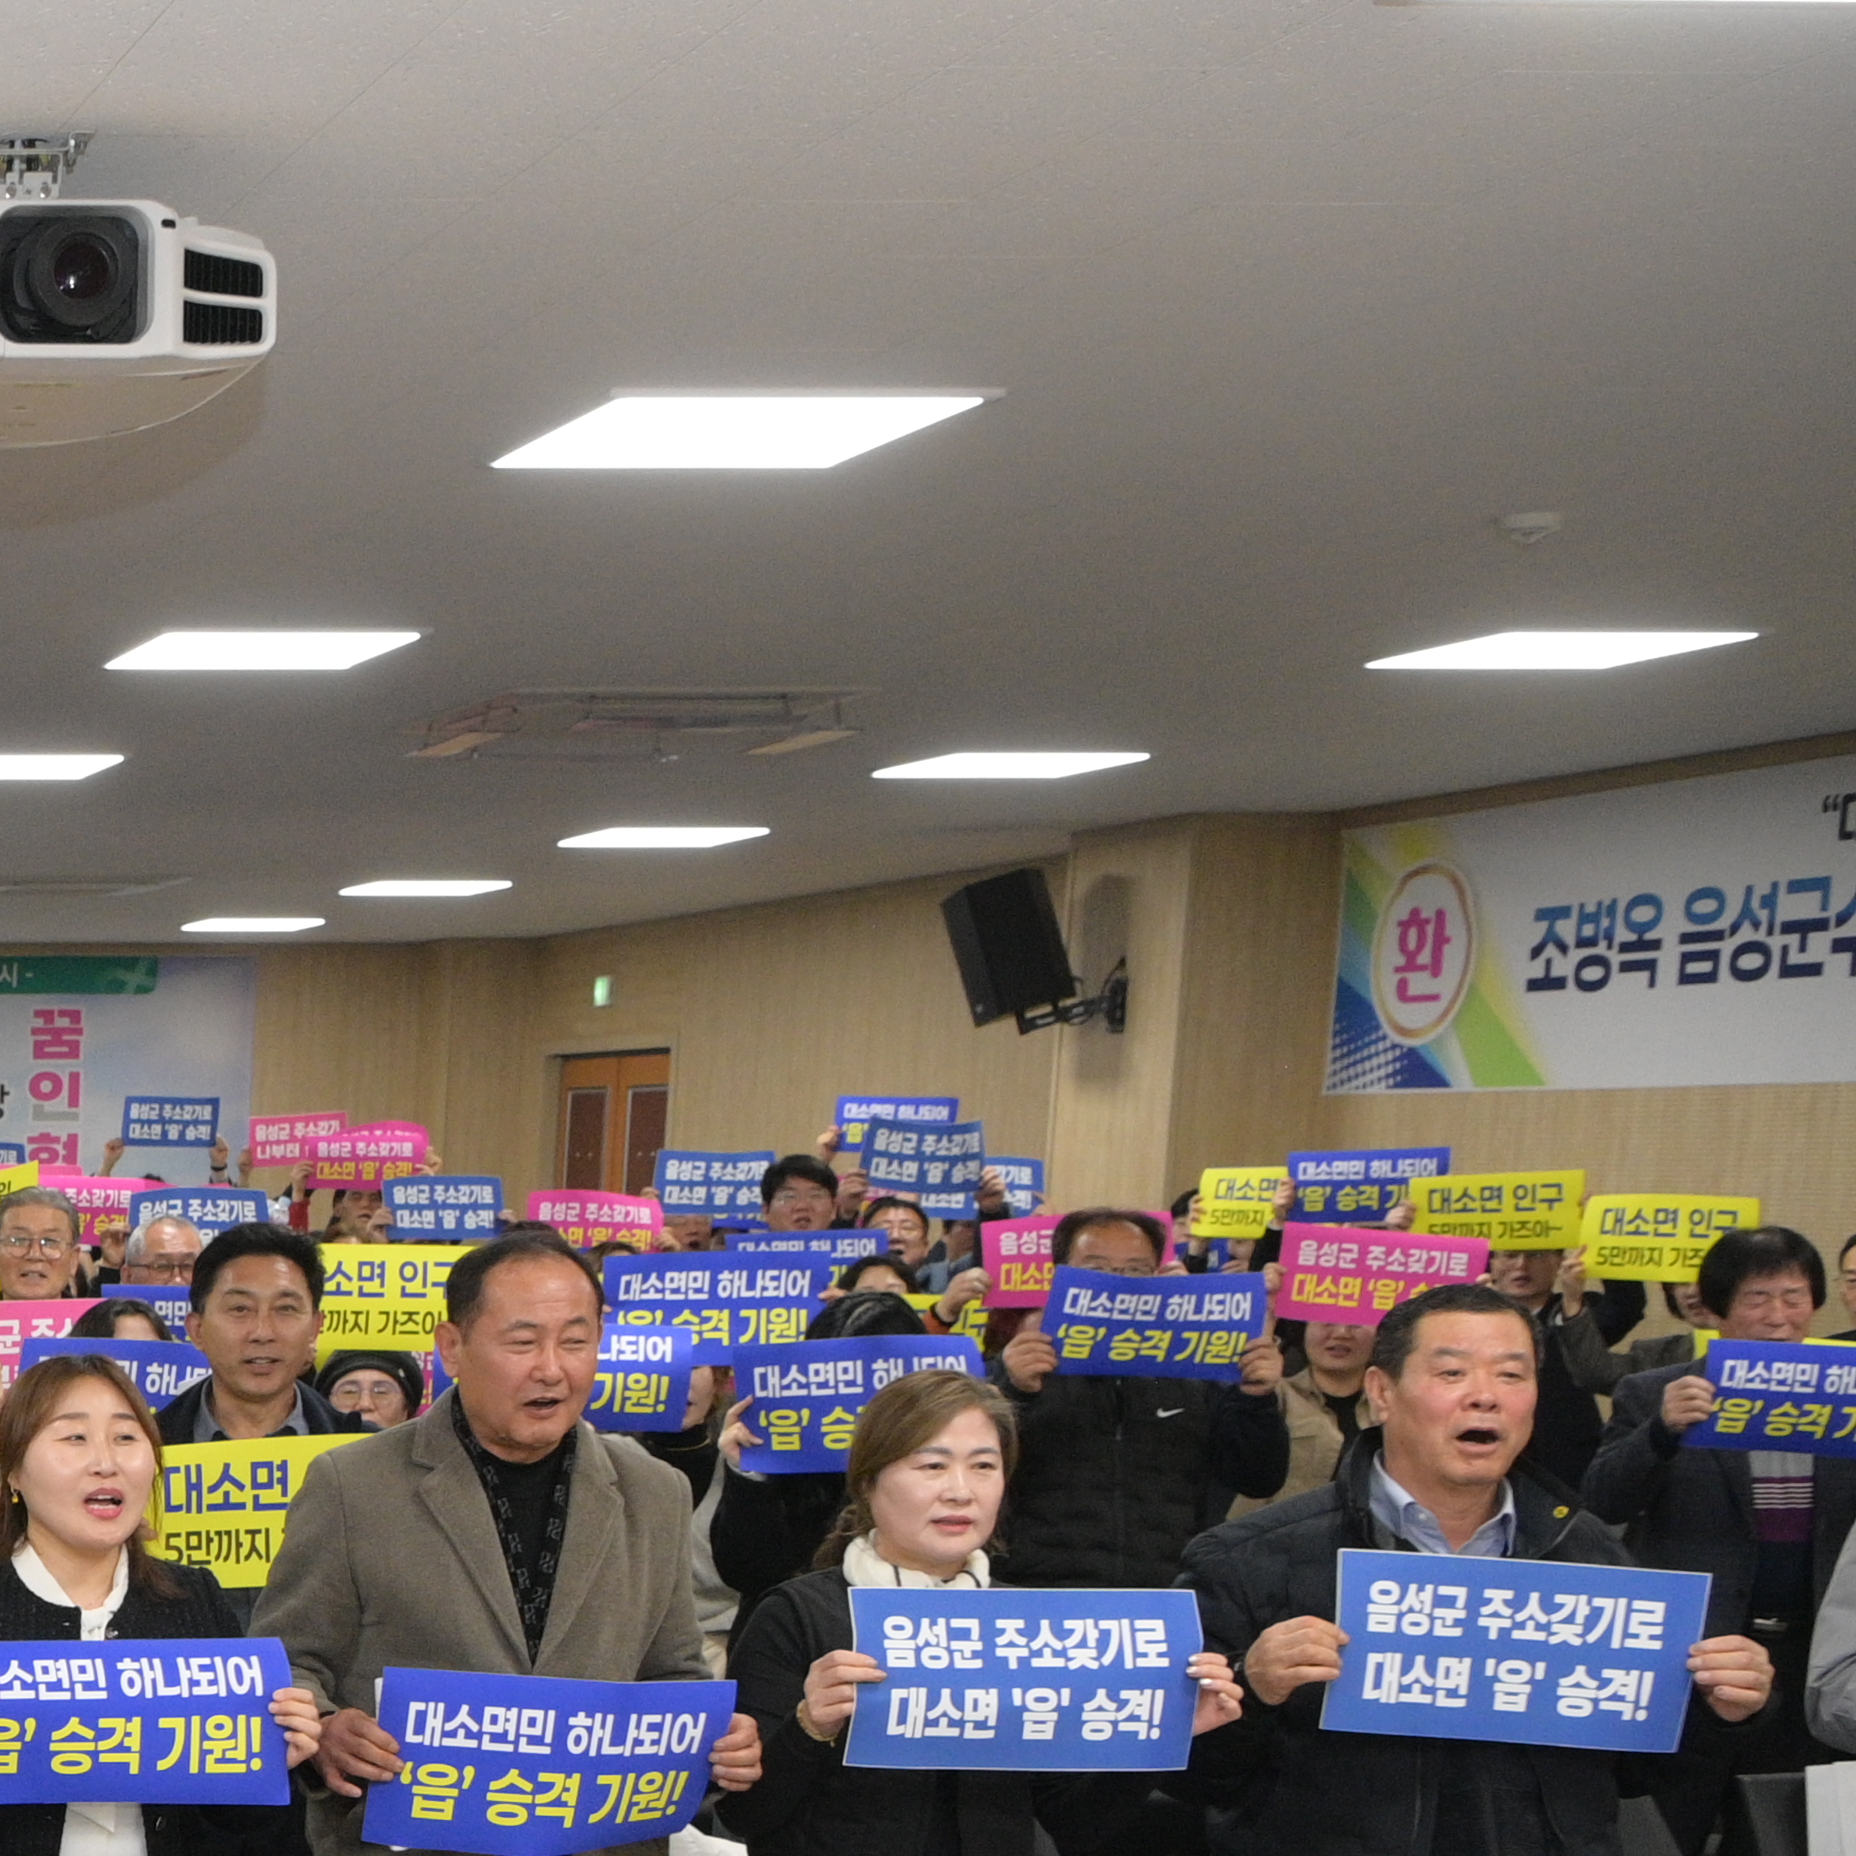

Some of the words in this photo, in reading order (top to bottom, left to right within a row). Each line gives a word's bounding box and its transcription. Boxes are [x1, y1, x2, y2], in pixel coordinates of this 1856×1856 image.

[1394, 906, 1451, 1005] 환
[1525, 892, 1664, 992] 조병옥
[30, 1008, 84, 1061] 꿈
[393, 1185, 430, 1204] 음성군
[433, 1185, 494, 1204] 주소갖기로
[1428, 1184, 1504, 1214] 대소면
[1513, 1183, 1563, 1212] 인구
[397, 1210, 435, 1229] 대소면
[464, 1210, 494, 1229] 승격!
[1298, 1241, 1359, 1269] 음성군
[1366, 1246, 1469, 1277] 주소갖기로
[619, 1271, 710, 1301] 대소면민
[718, 1269, 812, 1299] 하나되어
[1063, 1288, 1159, 1321] 대소면민
[1165, 1290, 1252, 1322] 하나되어
[1292, 1274, 1362, 1307] 대소면
[739, 1308, 807, 1345] 기원!
[1110, 1327, 1176, 1361] 승격
[1181, 1330, 1247, 1364] 기원!
[165, 1460, 289, 1514] 대소면
[165, 1531, 271, 1567] 5만까지
[1367, 1580, 1467, 1637] 음성군
[1477, 1588, 1666, 1650] 주소갖기로
[883, 1615, 983, 1670] 음성군
[994, 1618, 1170, 1670] 주소갖기로
[116, 1656, 264, 1699] 하나되어
[1362, 1651, 1471, 1708] 대소면
[1556, 1670, 1654, 1722] 승격!
[405, 1702, 556, 1755] 대소면민
[567, 1710, 706, 1757] 하나되어
[886, 1686, 997, 1739] 대소면
[1081, 1688, 1165, 1740] 승격!
[49, 1716, 141, 1775] 승격
[156, 1715, 262, 1775] 기원!
[485, 1768, 581, 1828] 승격
[588, 1770, 689, 1824] 기원!
